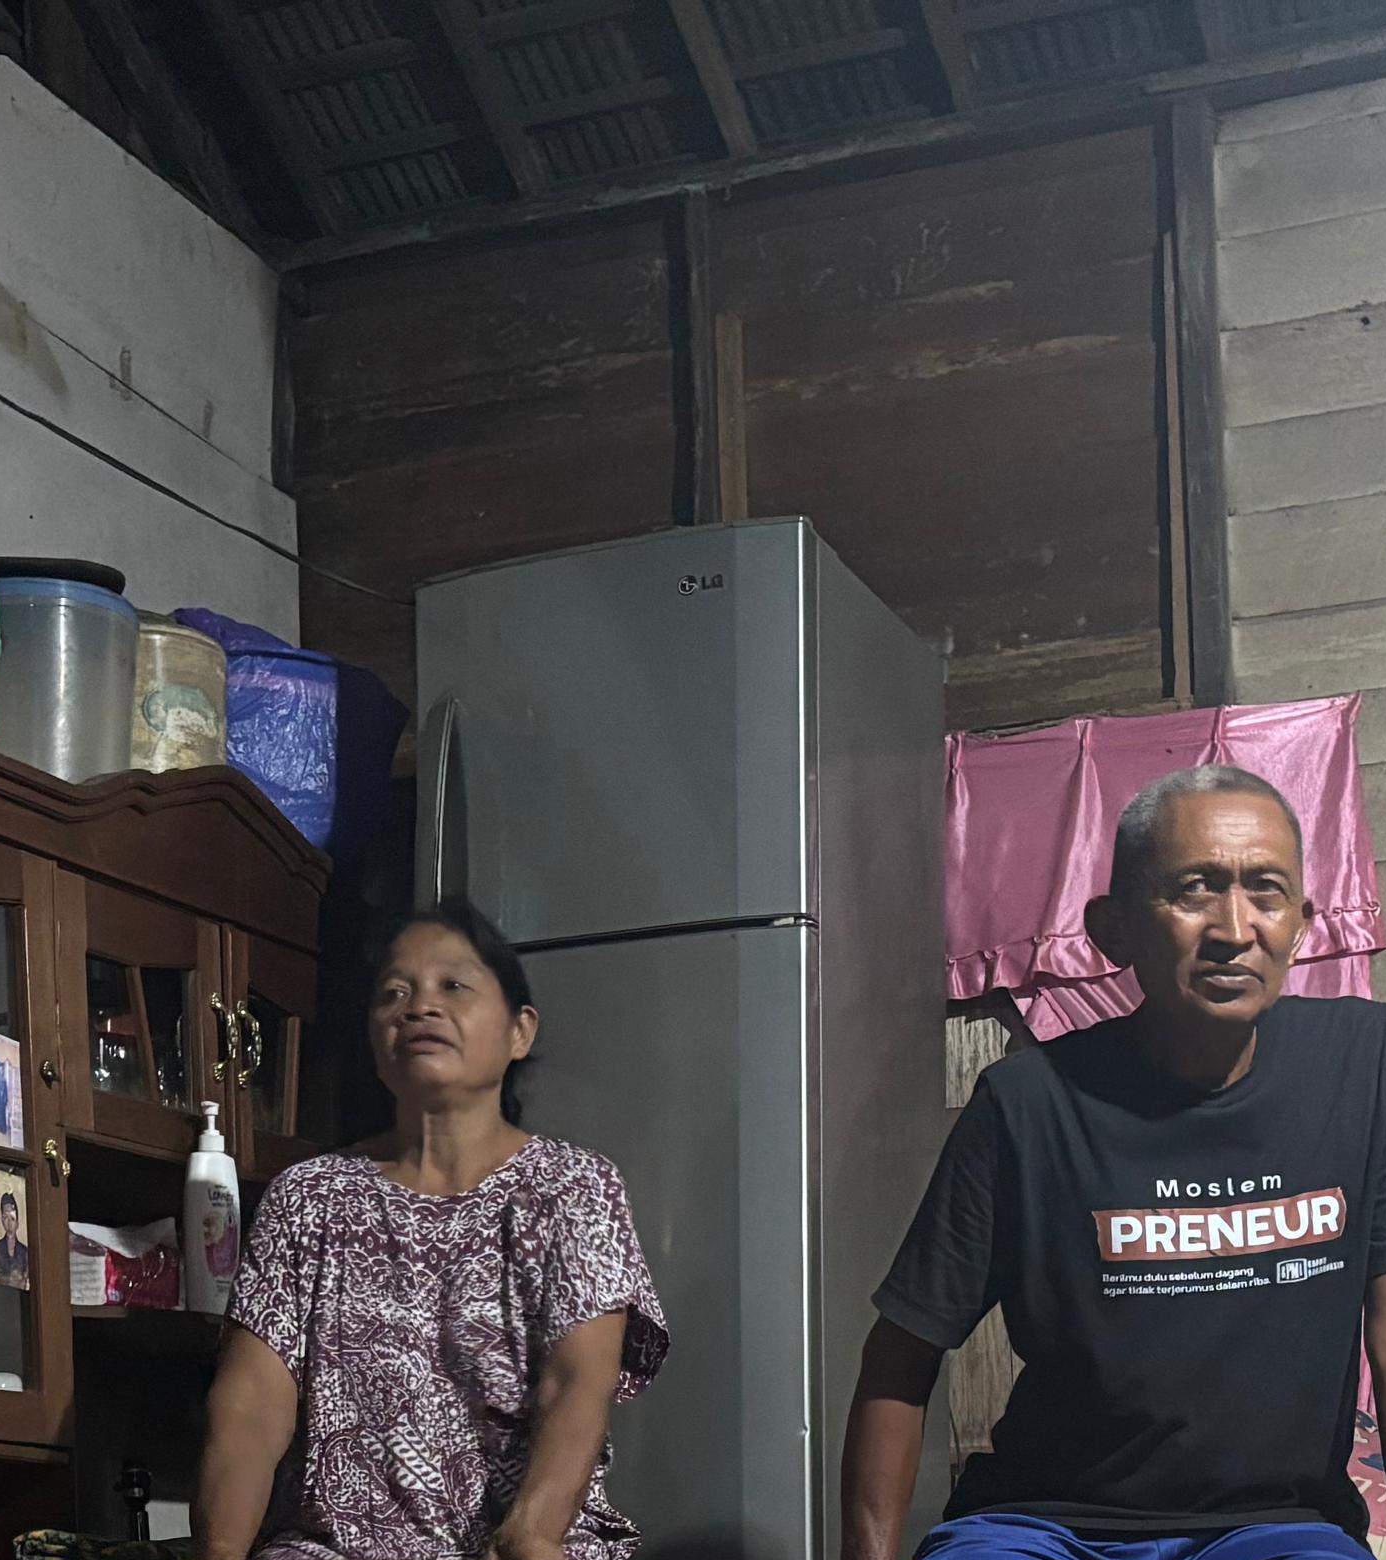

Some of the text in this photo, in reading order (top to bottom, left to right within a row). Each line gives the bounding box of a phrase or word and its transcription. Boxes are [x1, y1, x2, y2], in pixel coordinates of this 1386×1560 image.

[1156, 1174, 1282, 1198] Moslem
[1111, 1195, 1341, 1254] PRENEUR
[1144, 1273, 1168, 1282] dulu
[1215, 1267, 1254, 1280] dagang
[1103, 1286, 1127, 1297] agar
[1128, 1285, 1155, 1295] tidak
[1215, 1280, 1248, 1291] dalam
